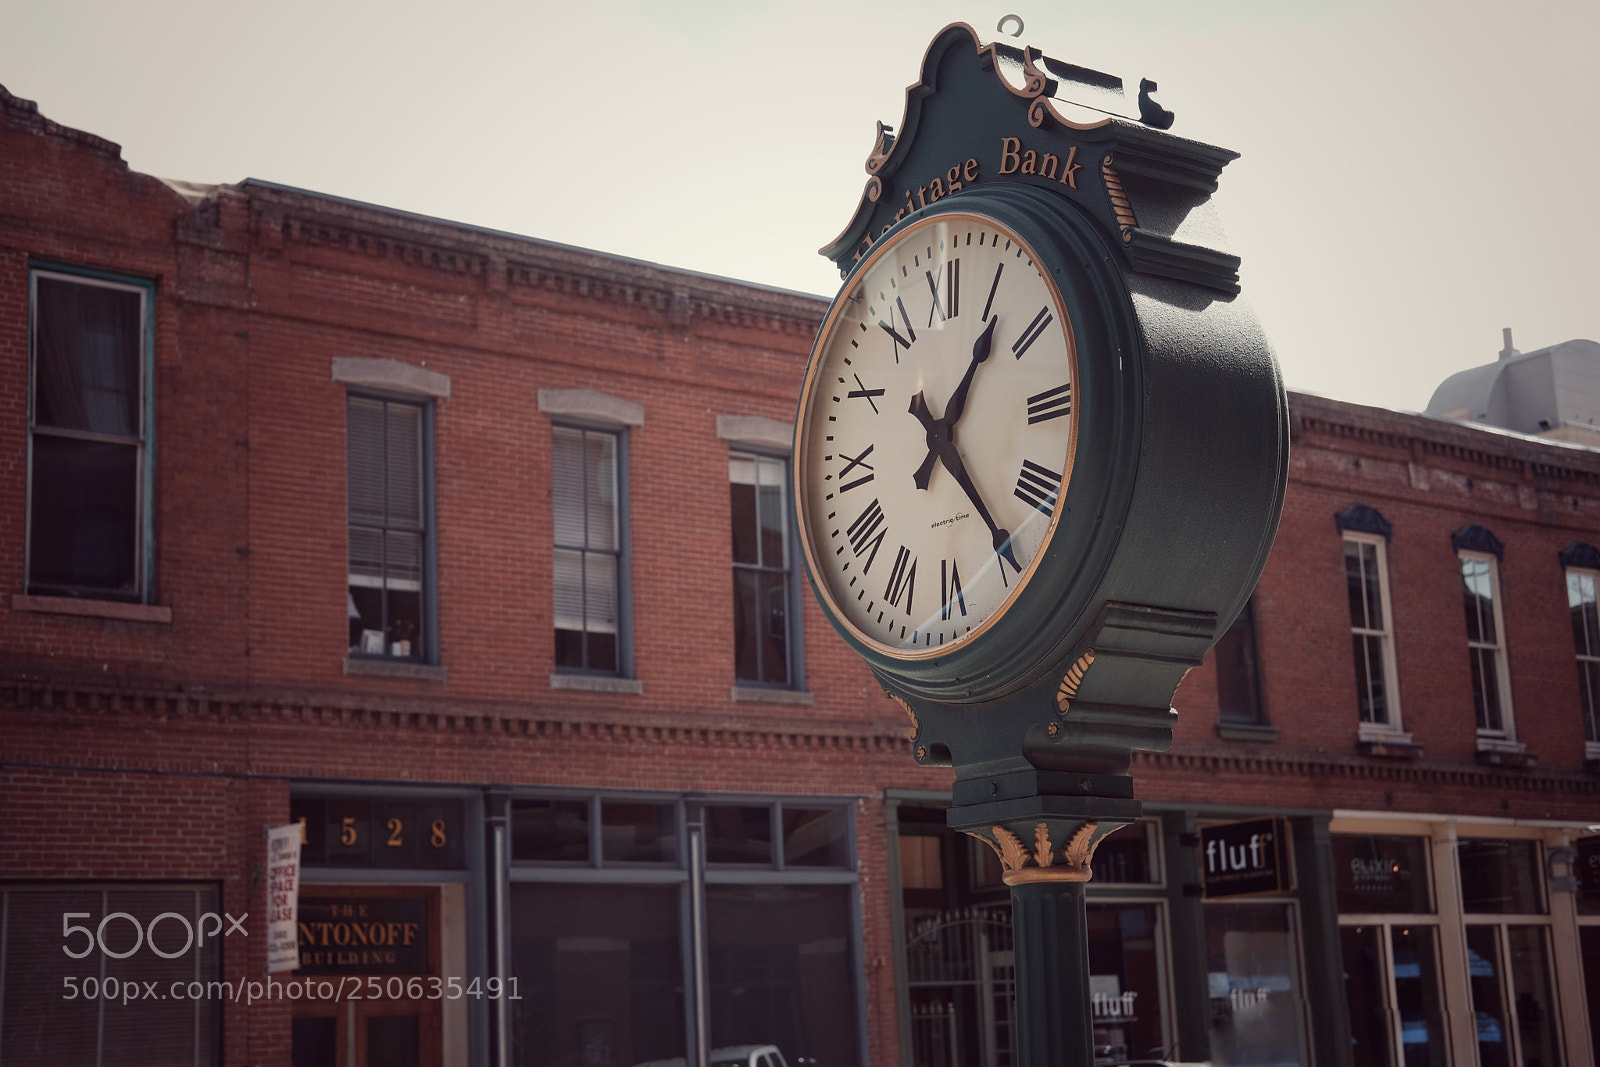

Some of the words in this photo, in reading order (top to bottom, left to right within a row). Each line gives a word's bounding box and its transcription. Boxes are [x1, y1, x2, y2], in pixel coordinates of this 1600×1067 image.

[998, 137, 1082, 189] Bank
[930, 517, 954, 529] electric
[955, 513, 970, 522] time
[1205, 834, 1268, 873] fluff
[330, 904, 369, 918] THE
[301, 951, 397, 966] BUILDING
[1093, 991, 1135, 1018] fluff
